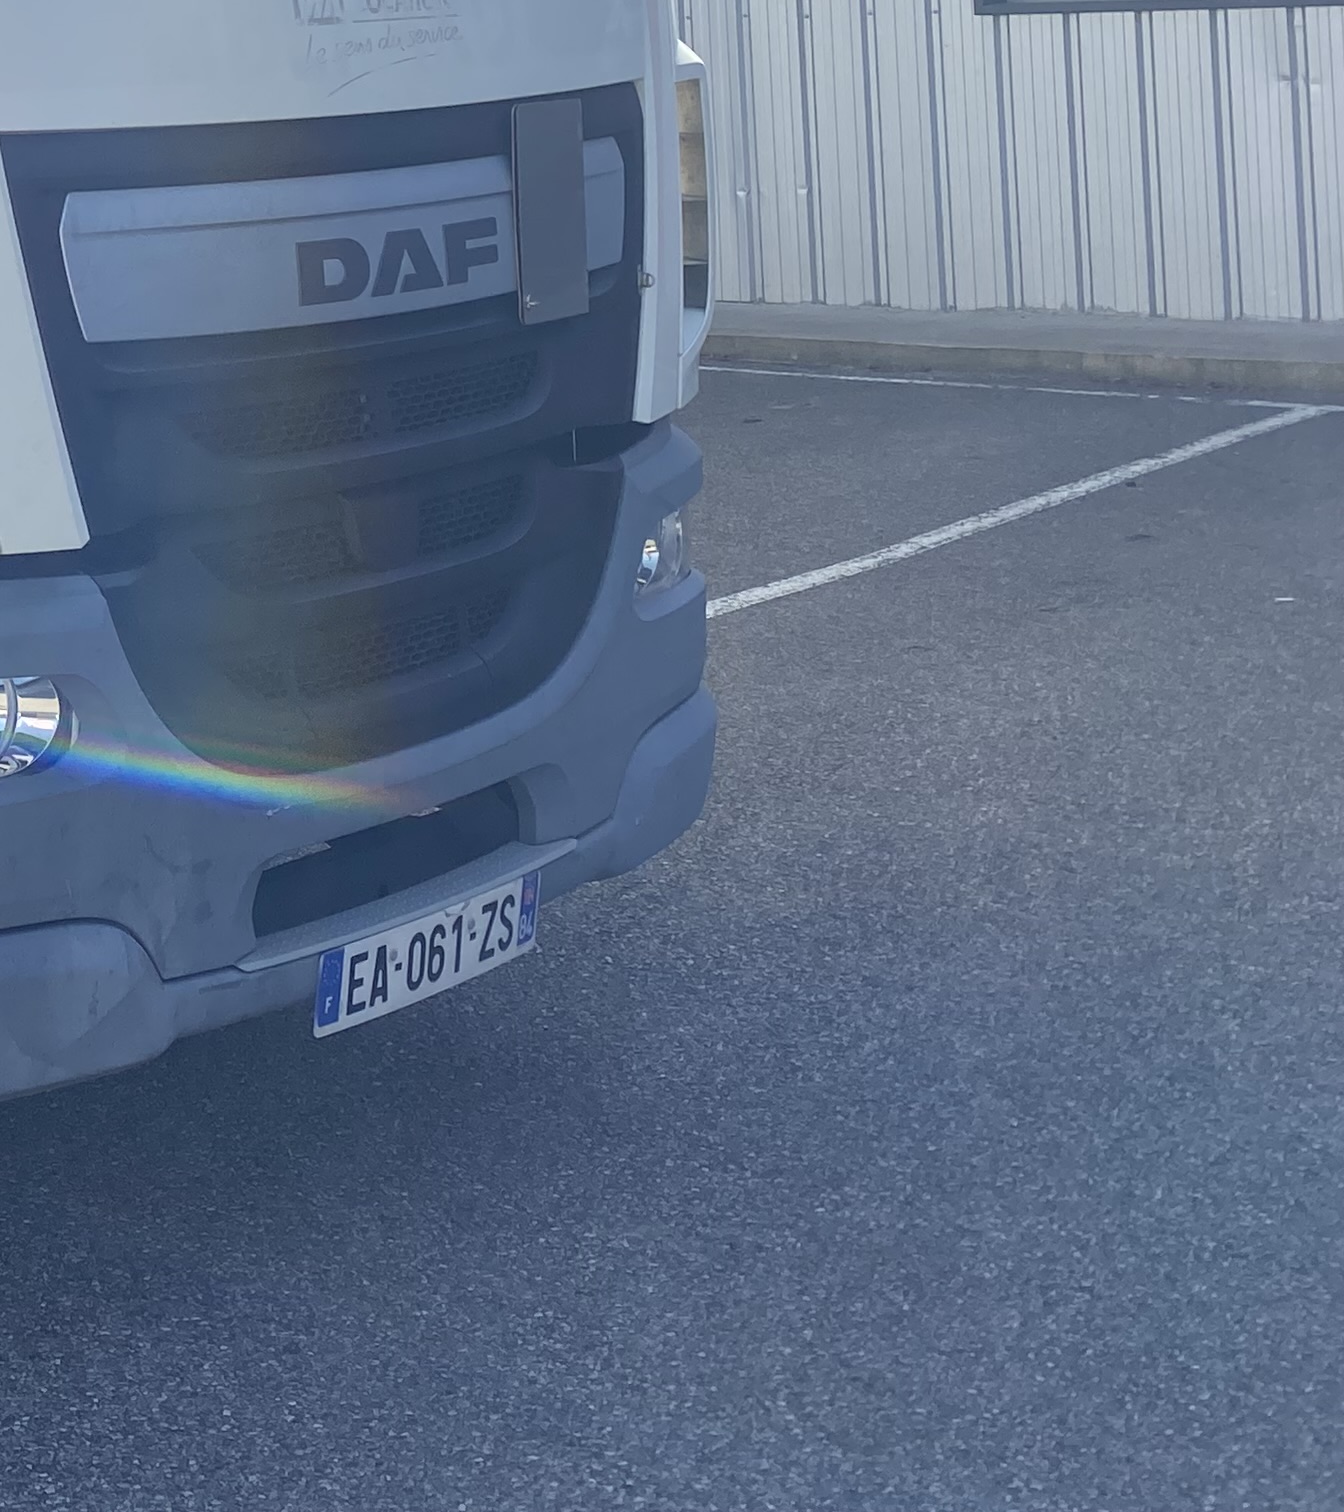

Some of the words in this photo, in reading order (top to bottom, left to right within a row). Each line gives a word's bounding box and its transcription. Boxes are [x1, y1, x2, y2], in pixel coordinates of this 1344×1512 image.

[407, 25, 464, 49] service
[295, 216, 500, 306] DAF
[519, 913, 534, 940] 84
[346, 894, 516, 1016] EA-061-ZS
[324, 996, 333, 1014] F
